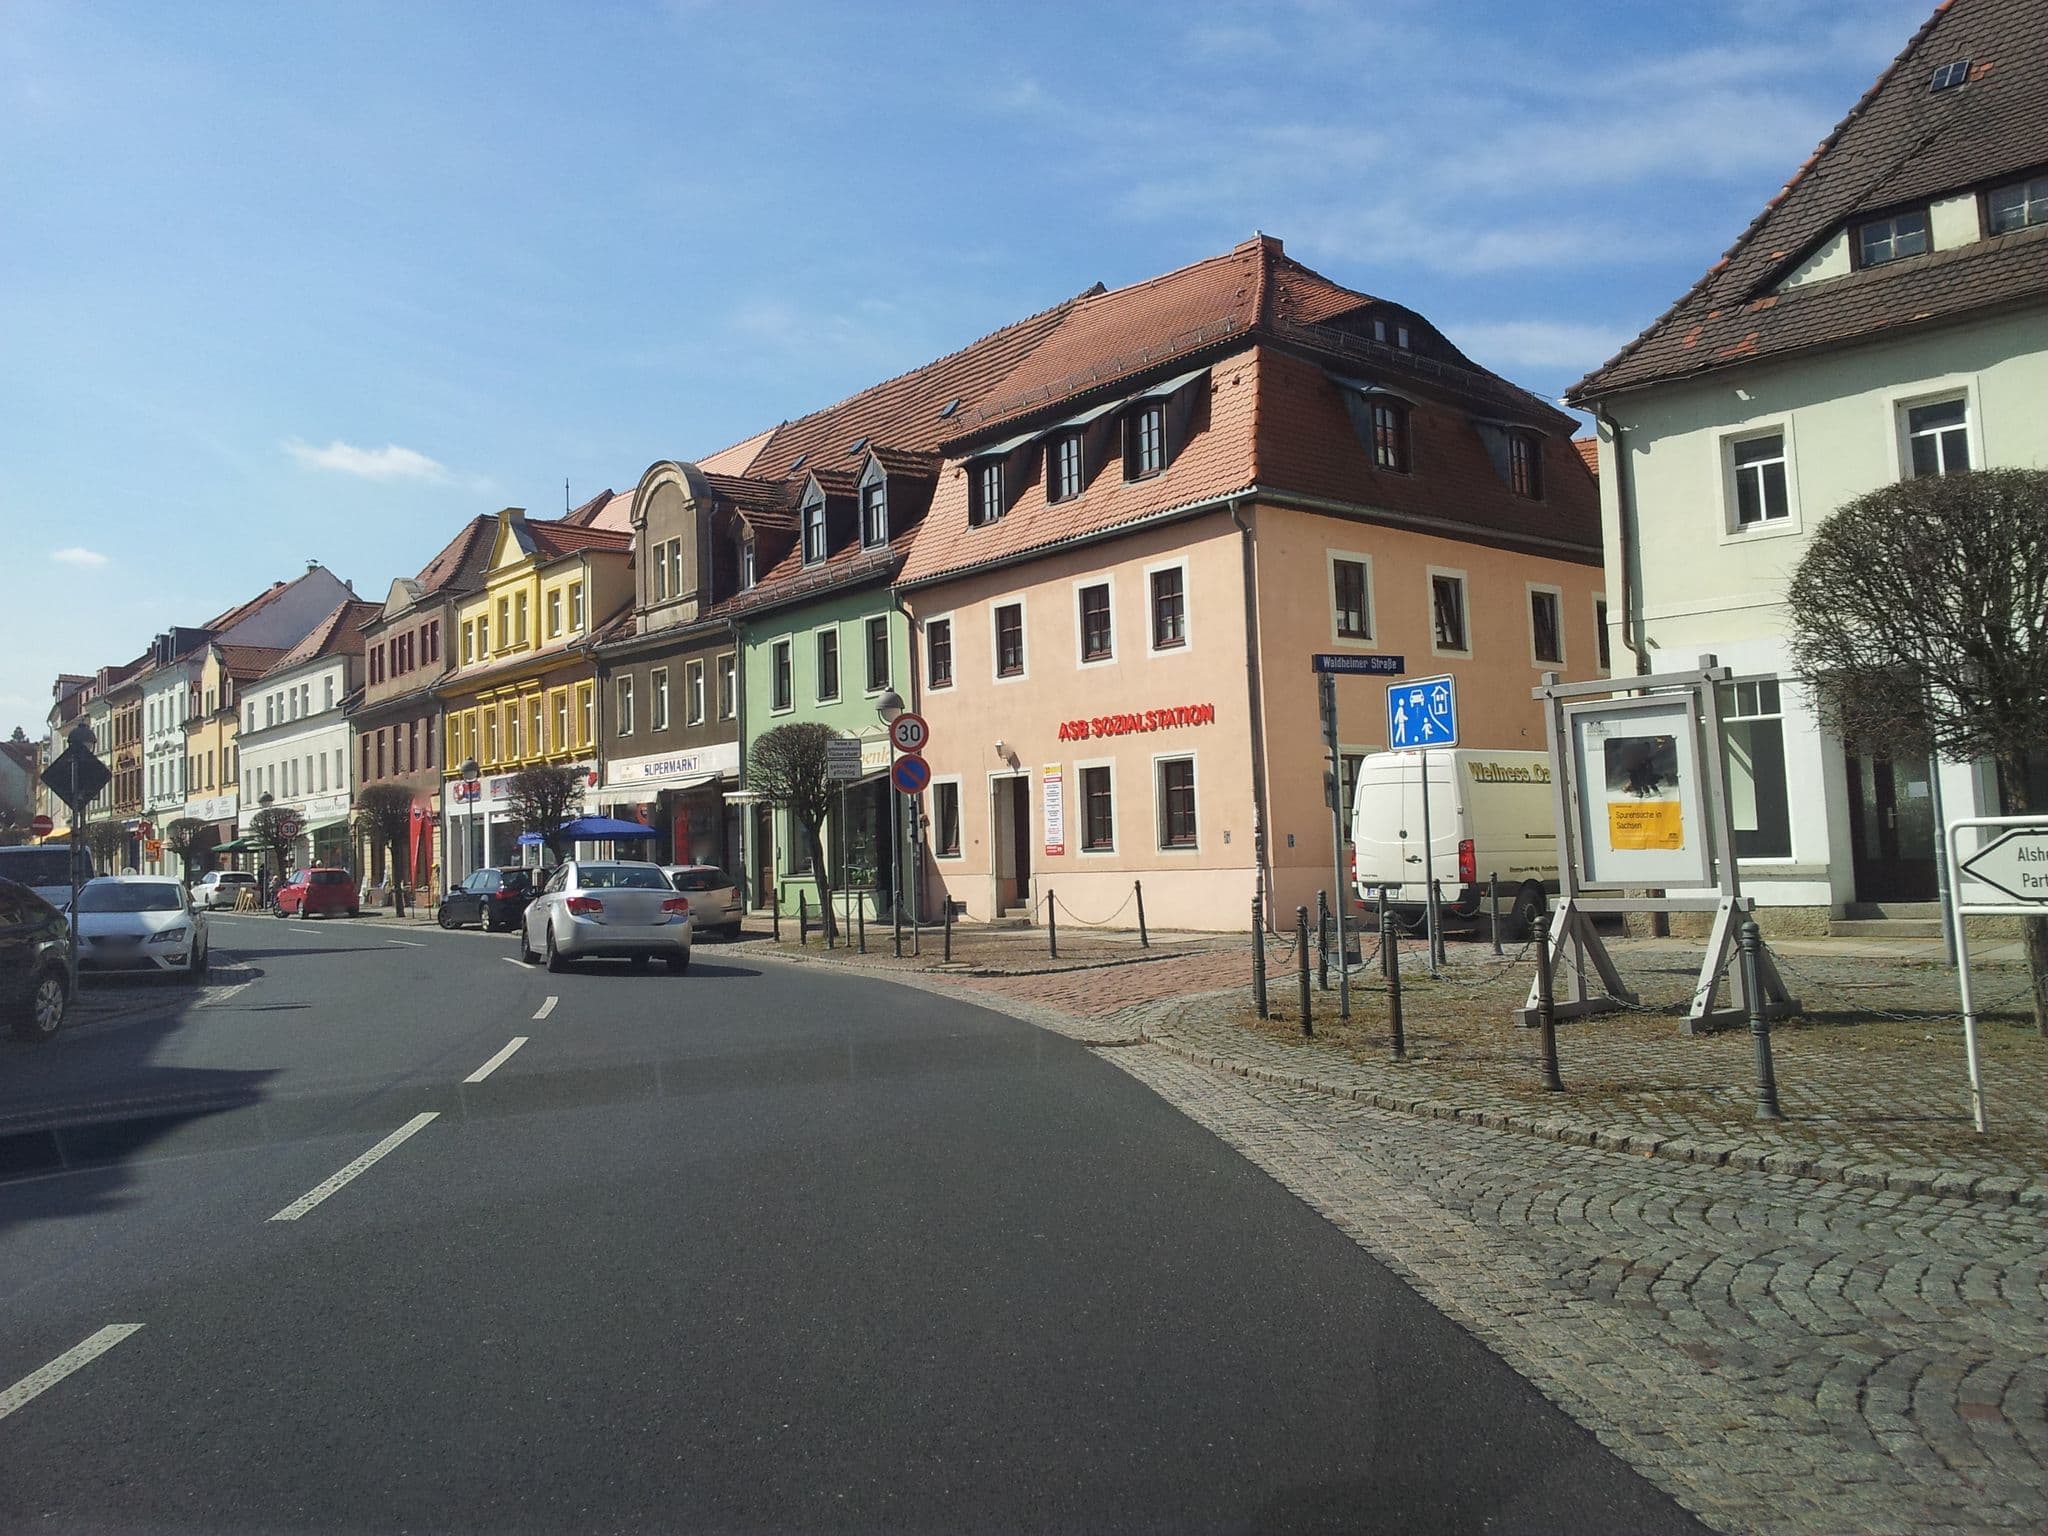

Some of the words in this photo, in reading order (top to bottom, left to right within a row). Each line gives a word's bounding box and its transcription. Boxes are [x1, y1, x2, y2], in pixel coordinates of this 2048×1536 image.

[1323, 656, 1368, 669] Waldheimer
[1371, 657, 1397, 671] Straße
[1058, 719, 1089, 742] ASB
[1091, 702, 1214, 738] SOZIALSTATION
[898, 724, 920, 742] 30
[644, 757, 697, 777] SUPERMARKT
[1468, 762, 1531, 783] Wellness
[1616, 821, 1642, 830] Sachsen
[2017, 846, 2048, 862] Alsh
